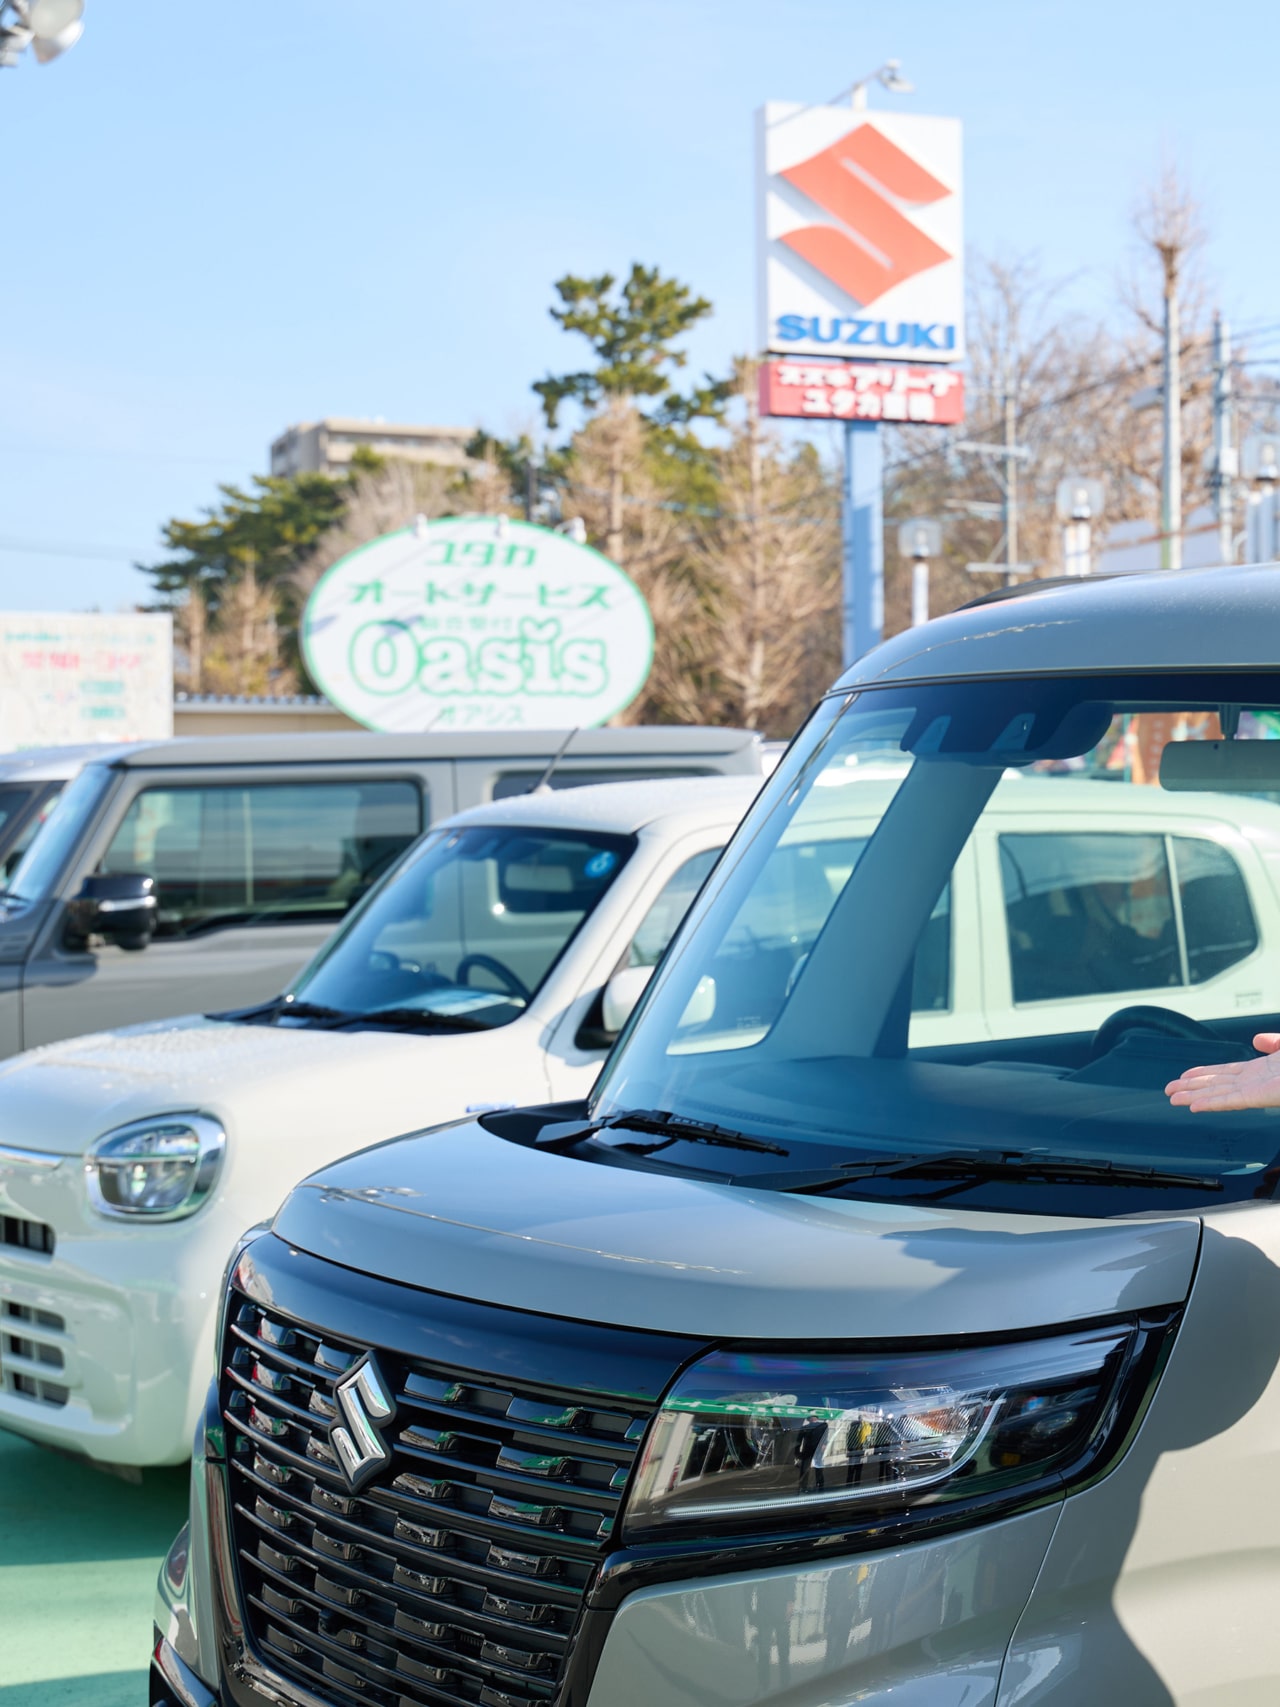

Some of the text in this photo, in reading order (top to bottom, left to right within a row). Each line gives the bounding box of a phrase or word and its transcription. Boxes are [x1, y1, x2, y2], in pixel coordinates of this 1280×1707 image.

[776, 314, 956, 350] SUZUKI
[424, 540, 537, 567] ユタカ
[349, 579, 613, 610] オートサービス
[349, 616, 610, 698] Oasis
